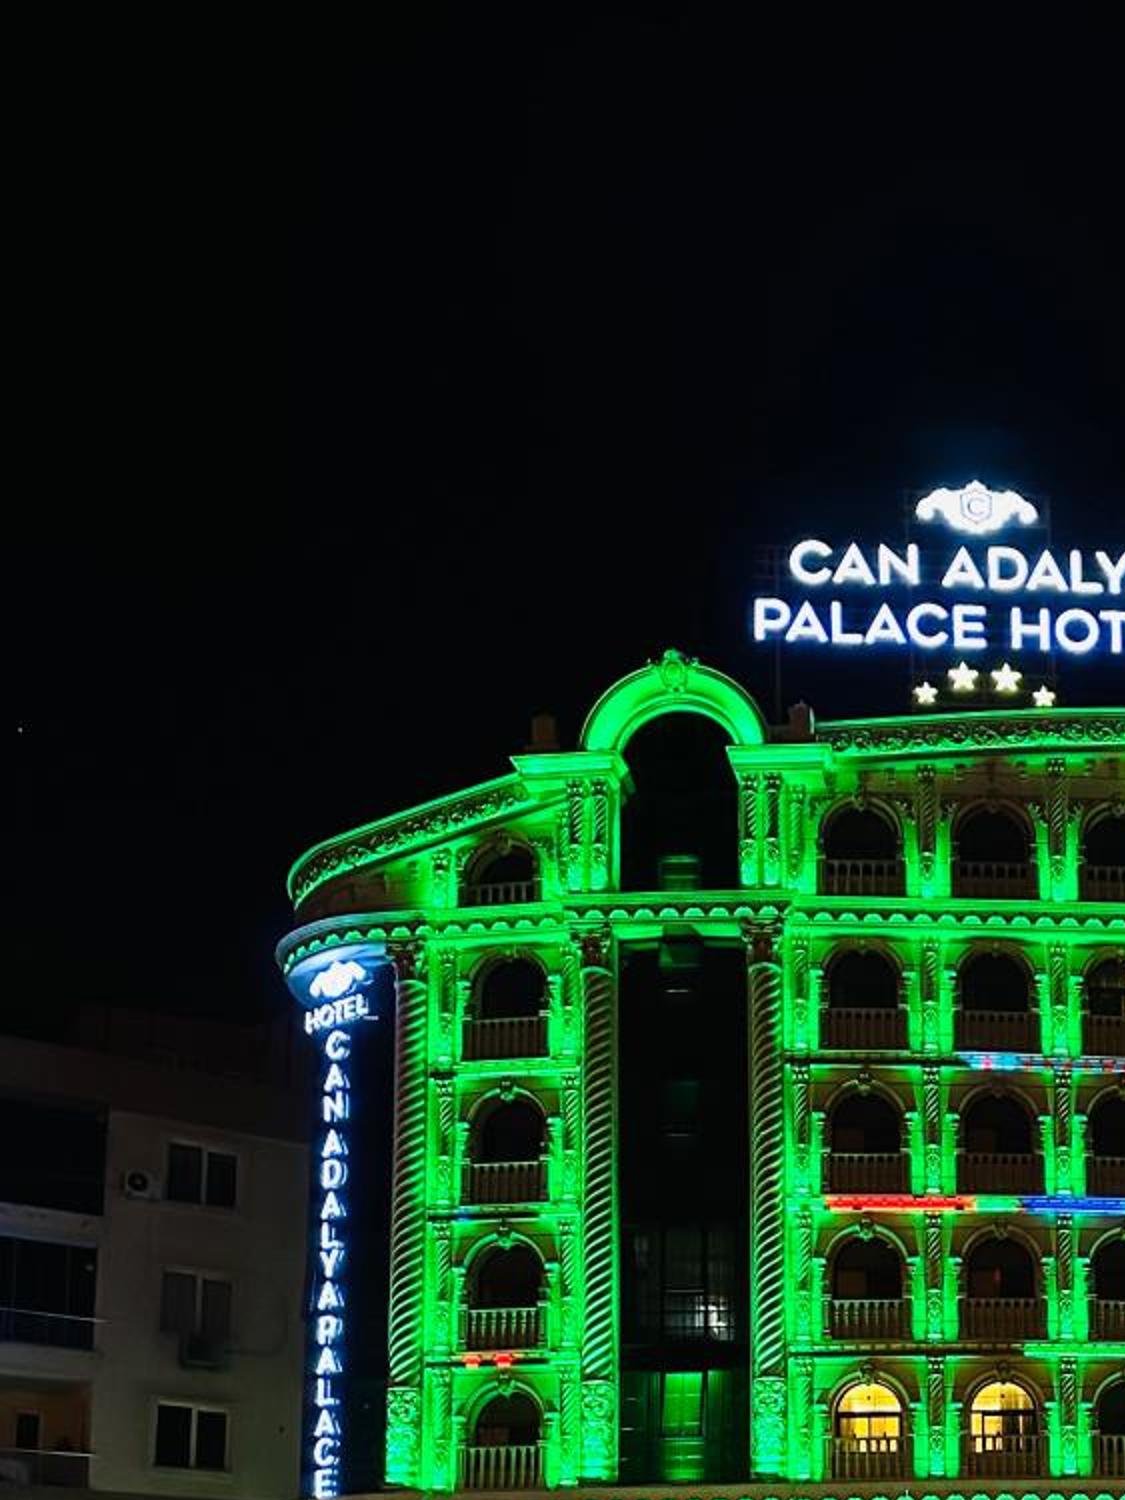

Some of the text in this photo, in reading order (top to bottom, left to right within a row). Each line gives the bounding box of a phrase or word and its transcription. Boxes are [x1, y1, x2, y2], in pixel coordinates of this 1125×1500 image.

[788, 539, 920, 586] CAN
[753, 597, 988, 649] PALACE
[304, 993, 369, 1035] HOTEL
[313, 1029, 351, 1500] CAN ADALYA PALACE
